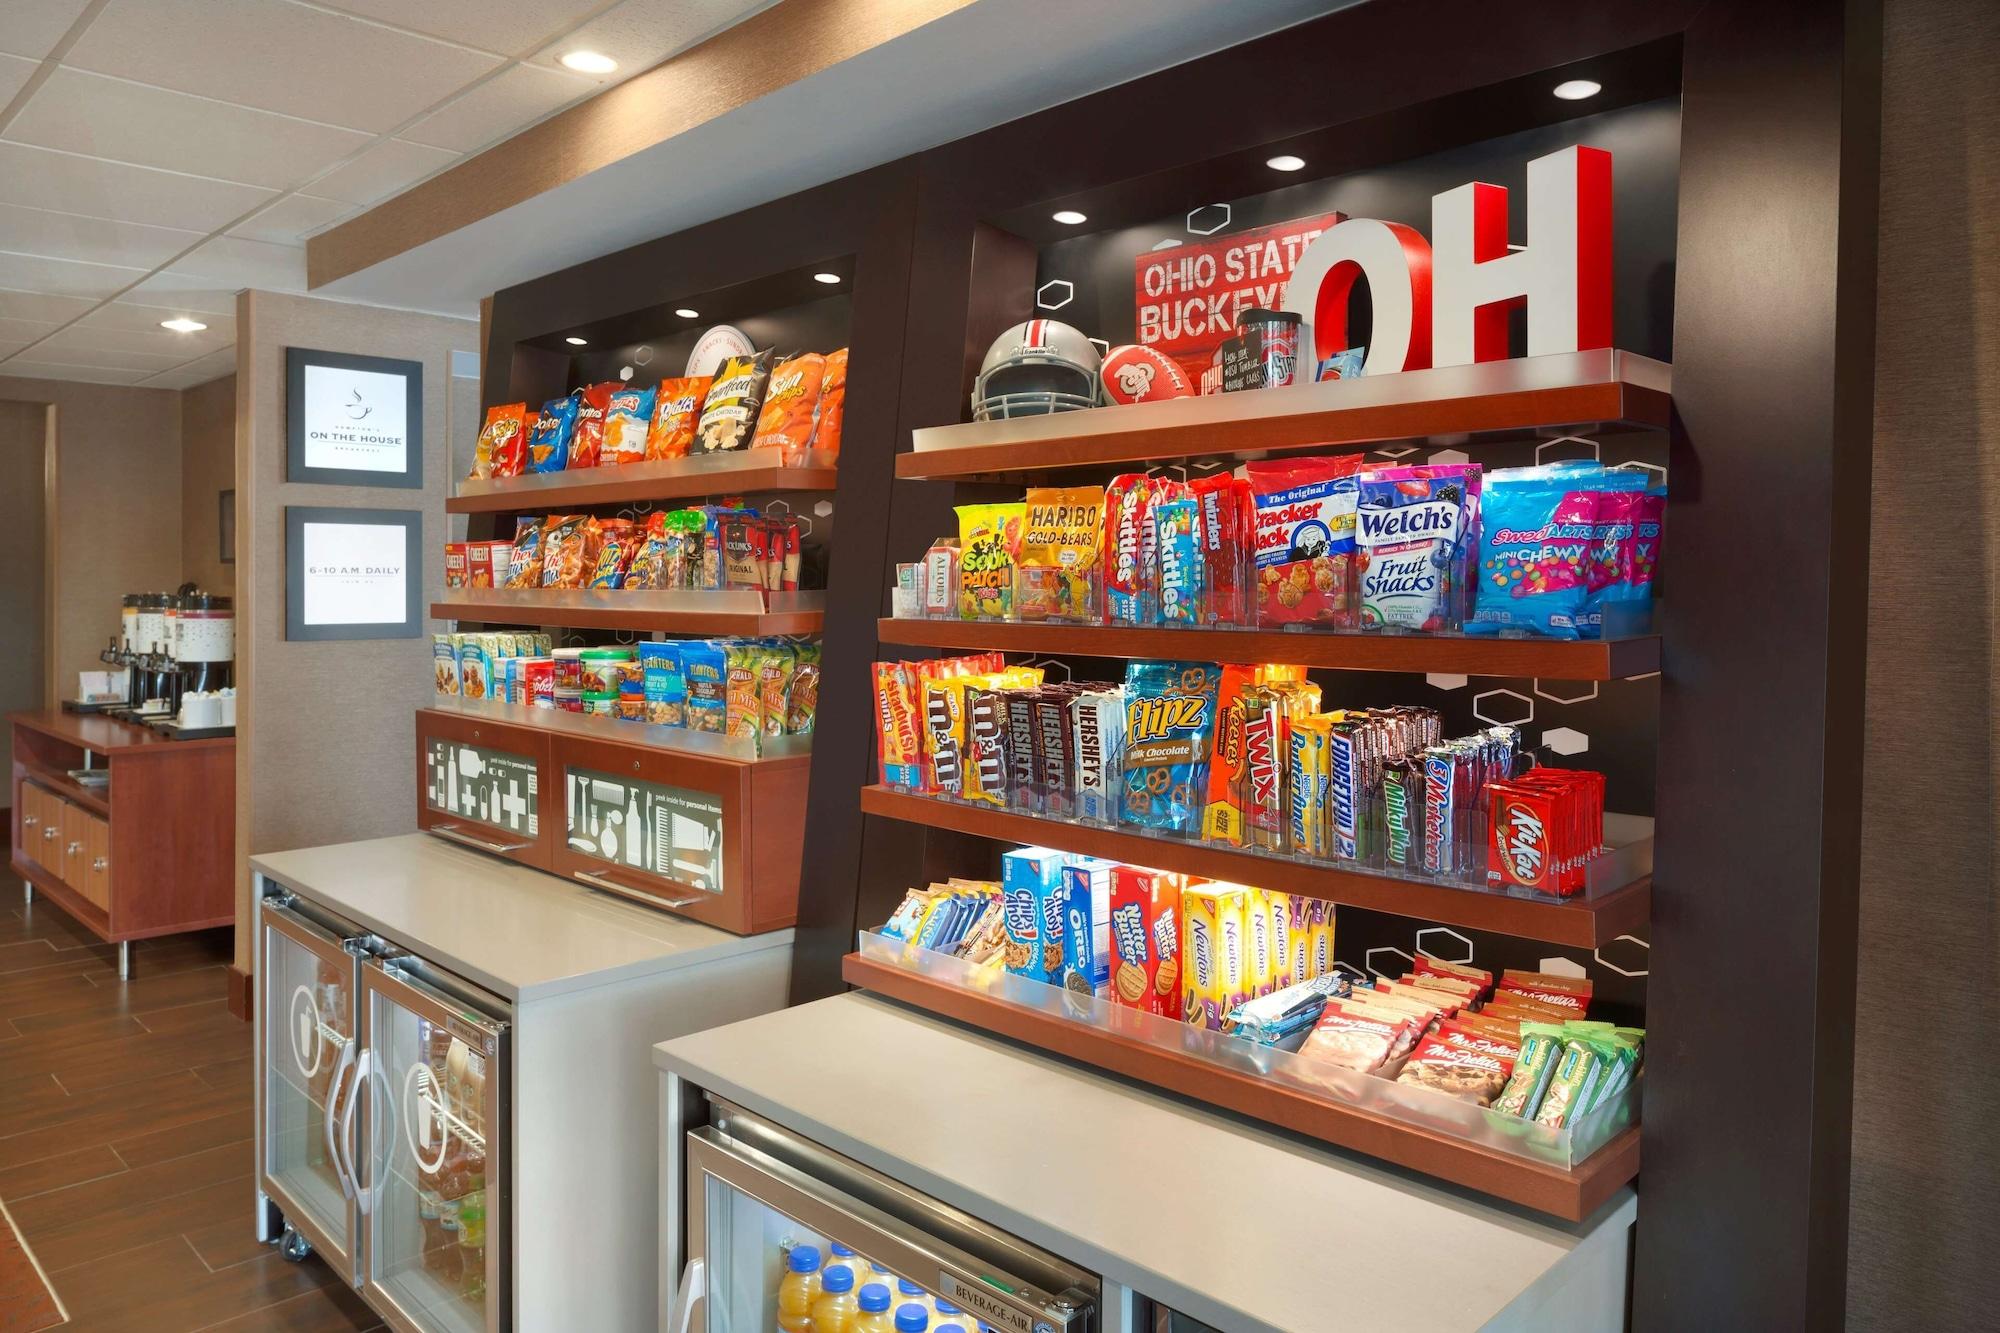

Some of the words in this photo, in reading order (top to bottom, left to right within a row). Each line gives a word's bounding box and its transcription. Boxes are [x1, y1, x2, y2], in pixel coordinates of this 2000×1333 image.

[1144, 252, 1217, 298] OHIO
[1288, 144, 1612, 376] OH
[310, 431, 328, 439] ON
[332, 433, 356, 441] THE
[361, 435, 402, 445] HOUSE
[1031, 505, 1097, 528] HARIBO
[1268, 494, 1287, 505] The
[1288, 484, 1326, 500] Original
[1027, 531, 1093, 546] GOLD-BEARS
[1117, 490, 1138, 582] Skittles
[1203, 490, 1221, 552] Twizzlers
[1360, 506, 1453, 538] Welch's
[963, 550, 1010, 572] SOUR
[1160, 520, 1183, 619] Skittles
[1376, 555, 1427, 580] Fruit
[1495, 552, 1517, 562] MINI
[1517, 545, 1587, 563] CHEWY
[937, 556, 945, 604] ALTOIDS
[961, 565, 1010, 590] PATCH
[1364, 572, 1435, 598] Snacks
[880, 689, 893, 732] minis
[887, 680, 914, 755] Starburst
[948, 693, 959, 717] PEANUT
[1010, 701, 1034, 785] HERSHEY'S
[1040, 706, 1065, 791] HERSHEY'S
[1079, 704, 1101, 789] HERSHEY'S
[1130, 751, 1145, 761] Milk
[1146, 745, 1190, 757] Chocolate
[1225, 697, 1247, 769] Reese's
[1245, 708, 1277, 804] TWIX
[1331, 735, 1353, 833] FORGETFUL
[1428, 757, 1447, 783] 3
[1215, 809, 1223, 832] SIZE
[1424, 778, 1449, 870] Musketeers
[1338, 839, 1355, 858] 2
[1015, 889, 1033, 931] Chips
[1124, 903, 1148, 962] Nutter
[1161, 908, 1178, 954] Nutter
[1069, 908, 1086, 969] OREO
[1112, 909, 1138, 967] Butter
[1153, 917, 1172, 962] Butter
[1193, 919, 1208, 987] Newtons
[1225, 921, 1237, 985] Newtons
[1254, 913, 1265, 977] Newtons
[1273, 904, 1286, 967] Newtons
[1206, 1001, 1214, 1019] Fig
[1453, 1048, 1502, 1071] Fields
[955, 1284, 1030, 1333] BEVERAGE-AIR
